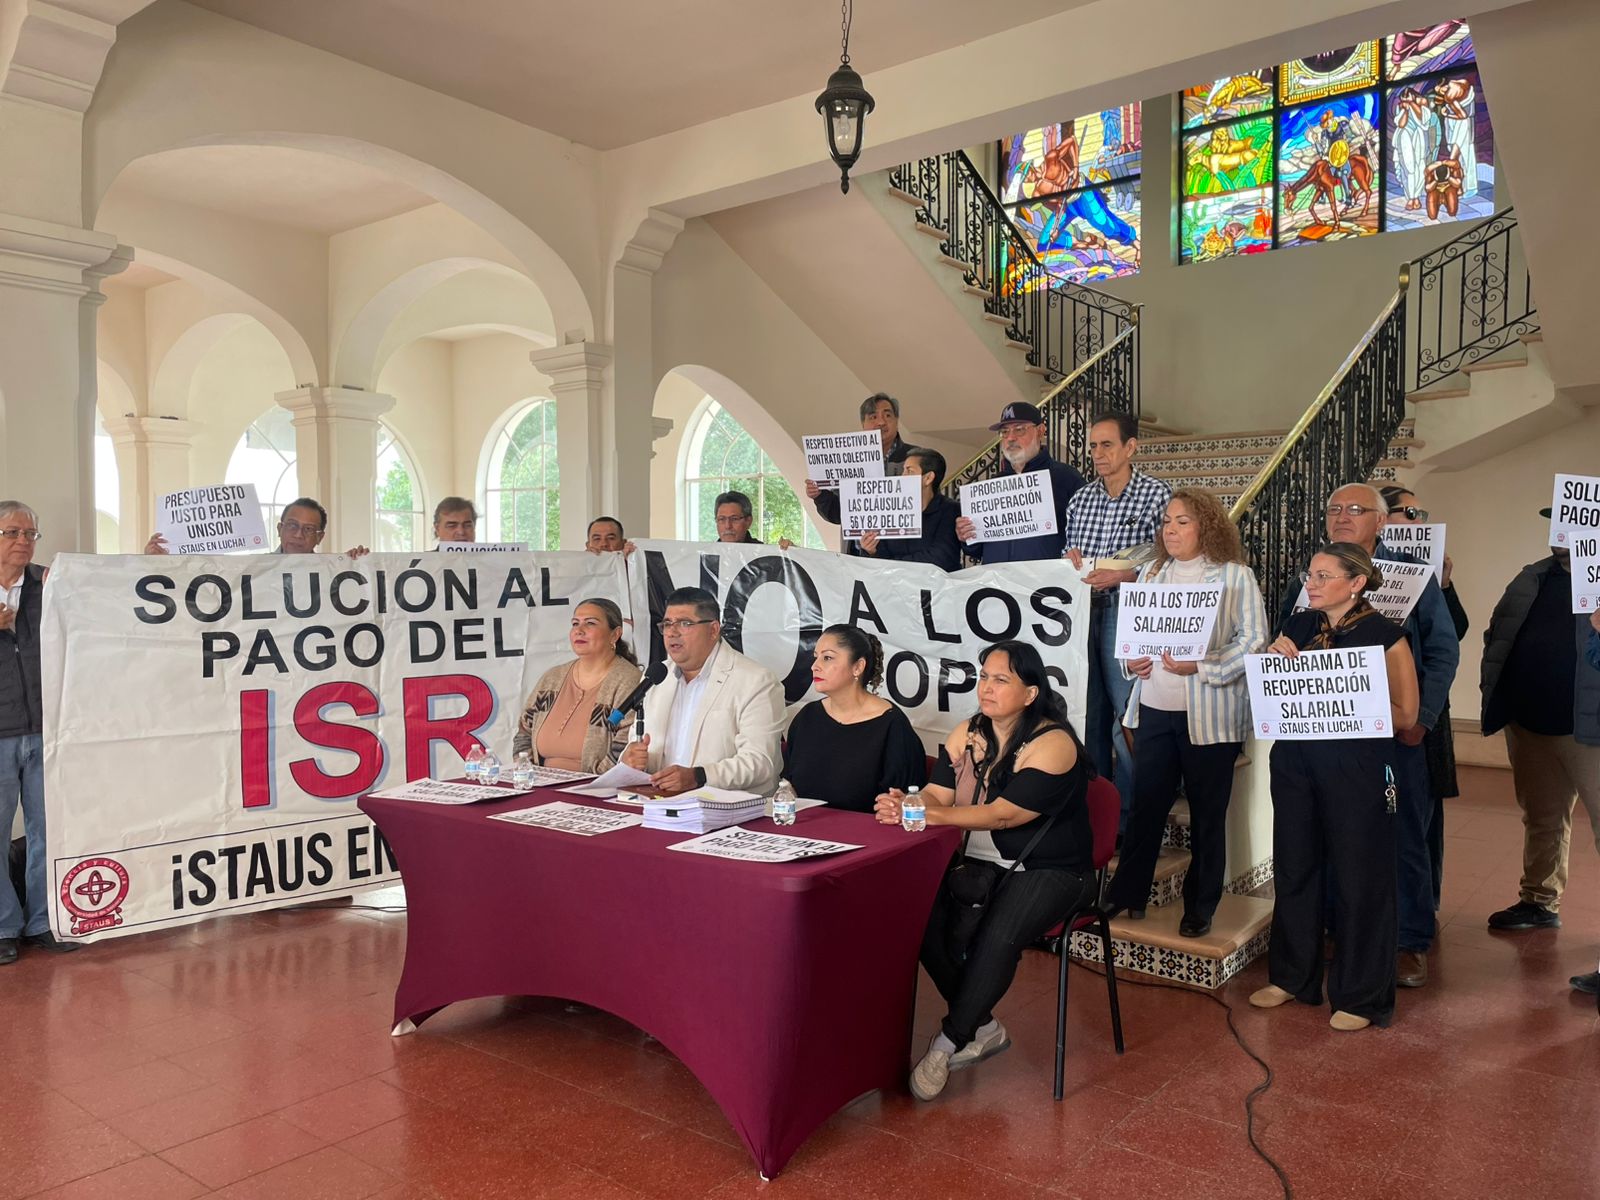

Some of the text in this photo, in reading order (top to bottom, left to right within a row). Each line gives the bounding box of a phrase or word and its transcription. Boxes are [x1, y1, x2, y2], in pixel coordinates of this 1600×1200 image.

[805, 433, 879, 450] RESPETO EFECTIVO AL
[807, 450, 881, 465] CONTRATO COLECTIVO
[825, 467, 865, 480] DE TRABAJO
[856, 480, 902, 495] RESPETO A
[970, 474, 1040, 498] ¡PROGRAMA DE
[165, 485, 246, 509] PRESUPUESTO
[848, 494, 914, 512] LAS CLÁUSULAS
[970, 489, 1042, 514] RECUPERACIÓN
[171, 502, 242, 524] JUSTO PARA
[850, 514, 915, 529] 56 Y 82 DEL CCT
[983, 509, 1033, 529] SALARIAL!
[1559, 505, 1600, 527] PAGO
[187, 520, 233, 539] UNISON
[984, 523, 1038, 538] ¡STAUS EN LUCHA!
[1416, 527, 1432, 541] DE
[179, 538, 246, 554] ¡STAUS EN LUCHA!
[1575, 538, 1597, 558] ¡NO
[1393, 564, 1419, 577] PLENO
[1418, 567, 1426, 576] A
[133, 558, 569, 624] SOLUCIÓN AL
[1390, 580, 1404, 590] DEL
[1124, 590, 1219, 608] ¡NO A LOS TOPES
[848, 579, 889, 635] A
[920, 586, 1072, 646] LOS
[1133, 615, 1205, 634] SALARIALES!
[201, 617, 524, 678] PAGO DEL
[1138, 644, 1162, 656] ¡STAUS
[1172, 645, 1194, 656] LUCHA!
[1261, 651, 1368, 674] ¡PROGRAMA DE
[1263, 671, 1371, 697] RECUPERACIÓN
[1280, 699, 1356, 719] SALARIAL!
[1279, 720, 1363, 734] ¡STAUS EN LUCHA!
[240, 673, 495, 809] ISR
[701, 837, 757, 849] PAGO
[751, 844, 791, 855] DEL
[172, 831, 334, 910] ¡STAUS
[83, 919, 111, 930] STAUS
